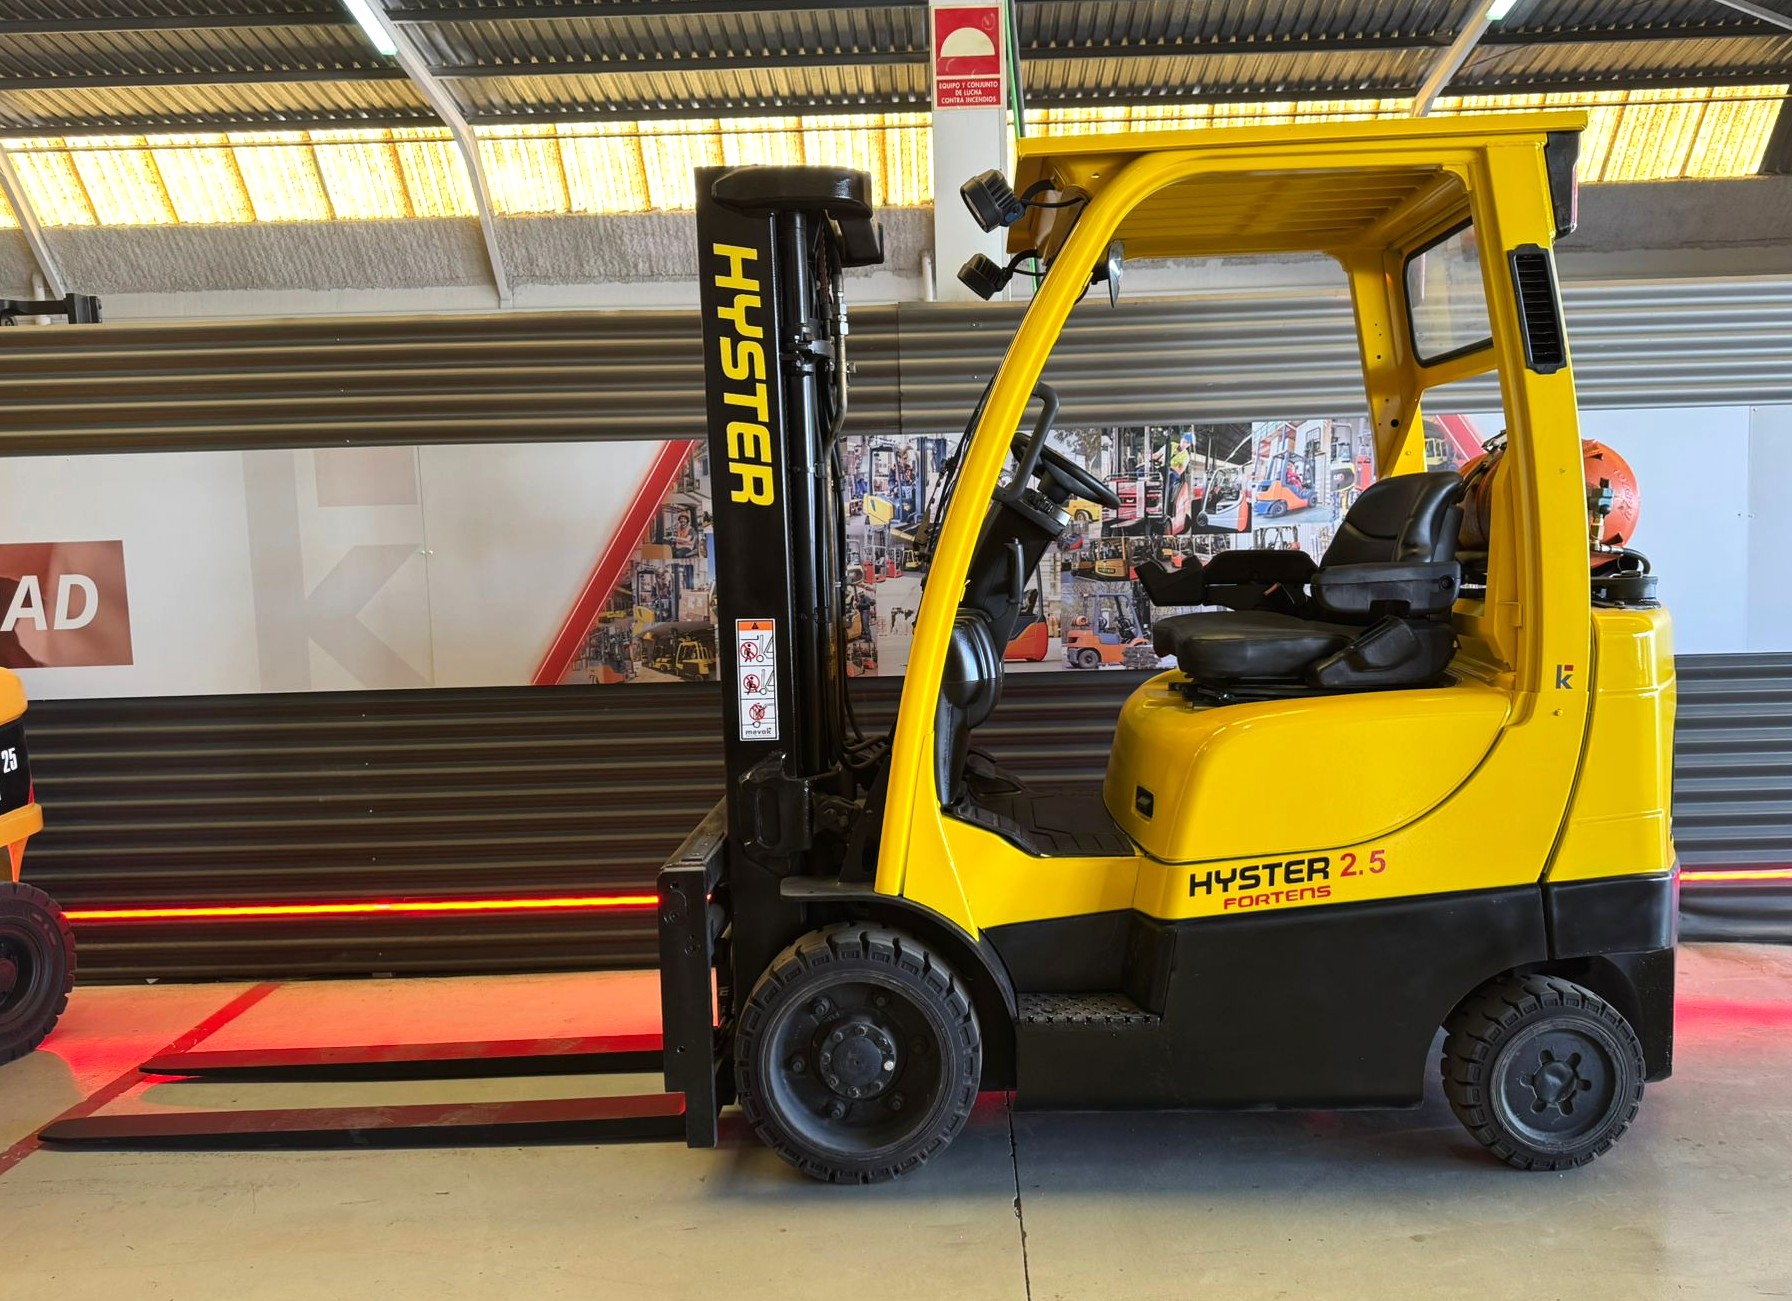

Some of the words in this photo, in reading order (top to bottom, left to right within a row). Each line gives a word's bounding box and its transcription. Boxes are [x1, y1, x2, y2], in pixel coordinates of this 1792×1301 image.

[712, 242, 775, 507] HYSTER
[0, 573, 99, 632] AD
[1, 746, 18, 774] 25
[1189, 856, 1330, 897] HYSTER
[1339, 849, 1387, 878] 2.5
[1223, 884, 1332, 910] FORTENS
